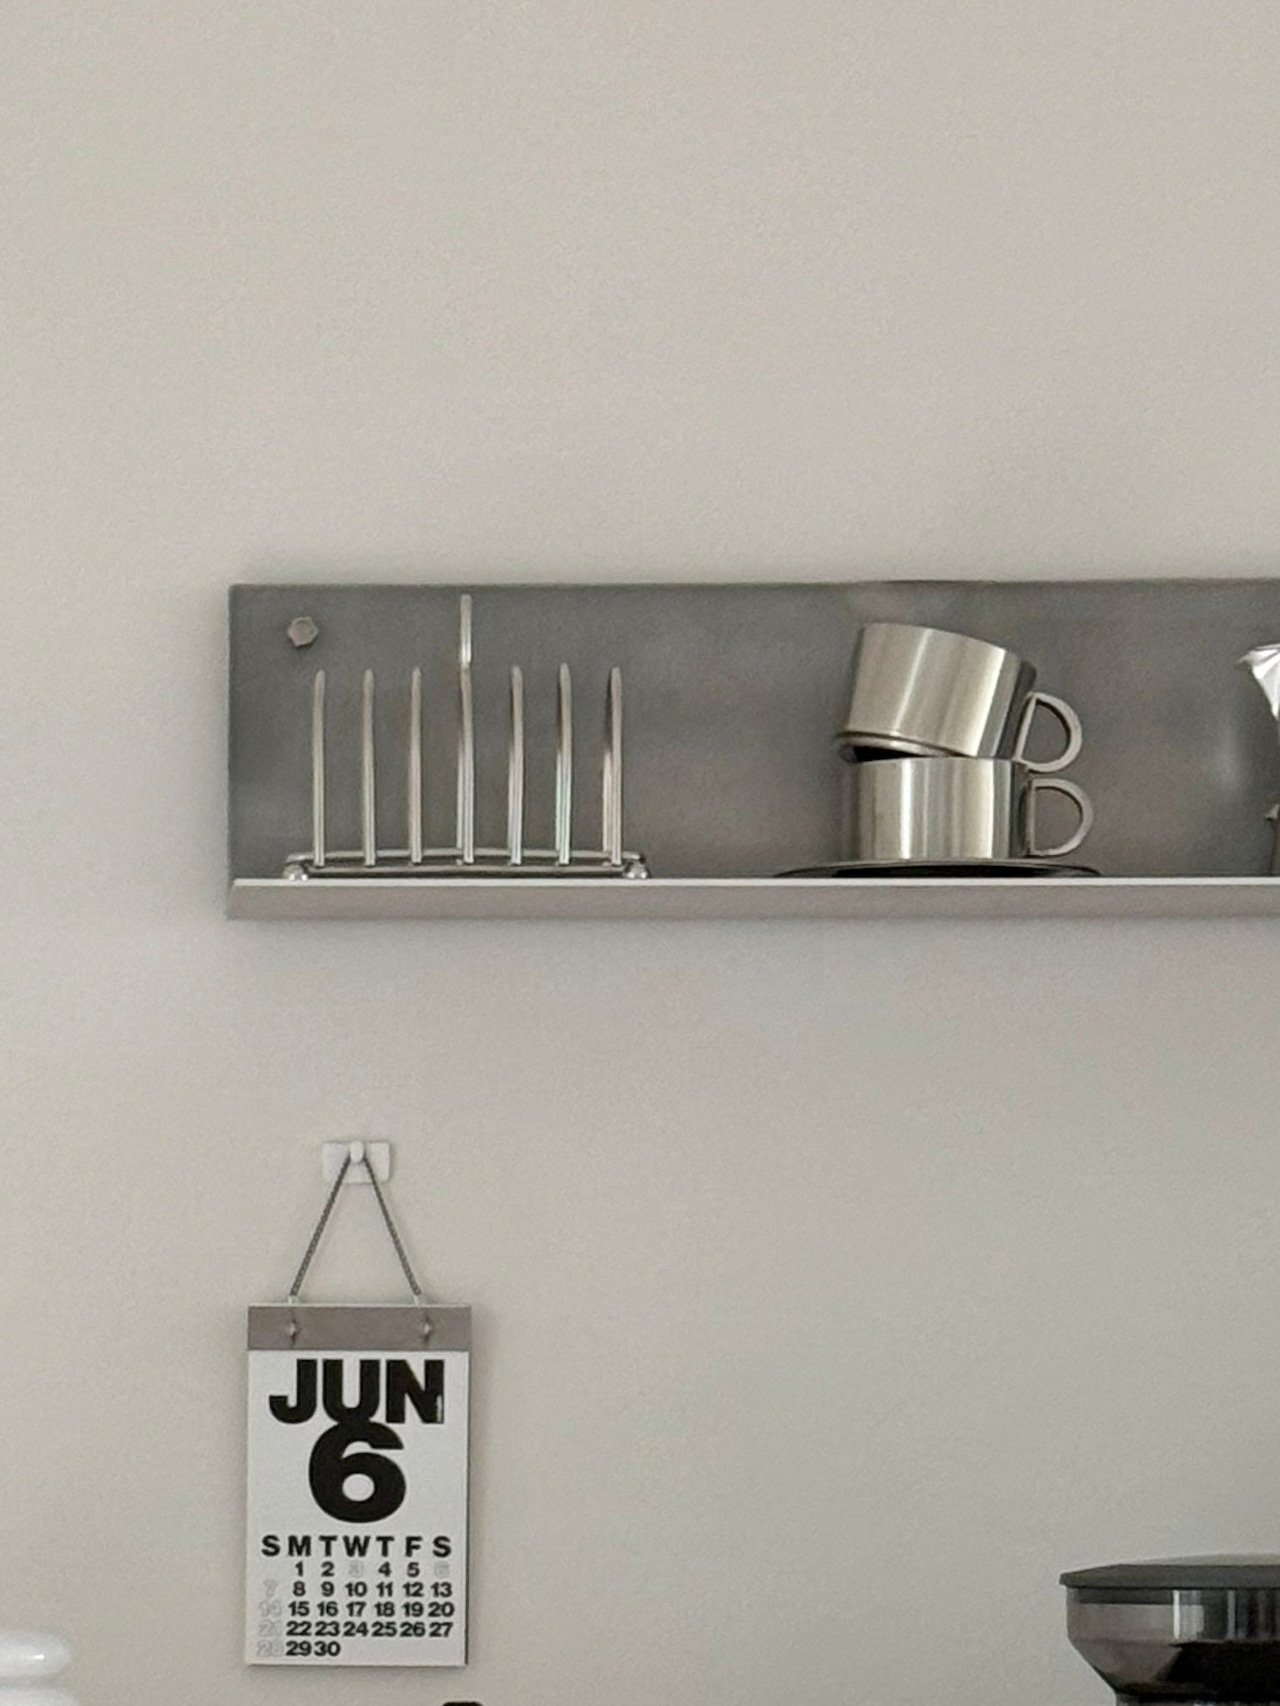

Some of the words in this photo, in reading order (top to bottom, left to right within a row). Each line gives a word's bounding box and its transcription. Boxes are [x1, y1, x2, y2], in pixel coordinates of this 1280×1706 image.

[268, 1358, 445, 1425] JUN
[308, 1421, 407, 1524] 6
[261, 1535, 281, 1557] S
[288, 1535, 311, 1557] M
[319, 1535, 338, 1557] T
[343, 1535, 370, 1557] W
[376, 1535, 395, 1557] T
[405, 1535, 423, 1557] F
[432, 1535, 452, 1557] S
[295, 1561, 304, 1578] 1
[320, 1561, 335, 1578] 2
[378, 1561, 392, 1578] 4
[407, 1561, 420, 1578] 5
[292, 1581, 306, 1597] 8
[320, 1581, 335, 1597] 9
[345, 1581, 368, 1597] 10
[376, 1581, 394, 1597] 11
[402, 1581, 424, 1597] 12
[430, 1581, 453, 1597] 13
[288, 1601, 310, 1617] 15
[317, 1601, 339, 1617] 16
[346, 1601, 366, 1617] 17
[374, 1601, 395, 1617] 18
[402, 1601, 424, 1617] 19
[428, 1601, 455, 1617] 20
[286, 1621, 312, 1637] 22
[315, 1621, 340, 1637] 23
[343, 1621, 369, 1637] 24
[371, 1621, 397, 1637] 25
[399, 1621, 426, 1637] 26
[429, 1621, 454, 1637] 27
[285, 1641, 312, 1657] 29
[314, 1641, 341, 1657] 30
